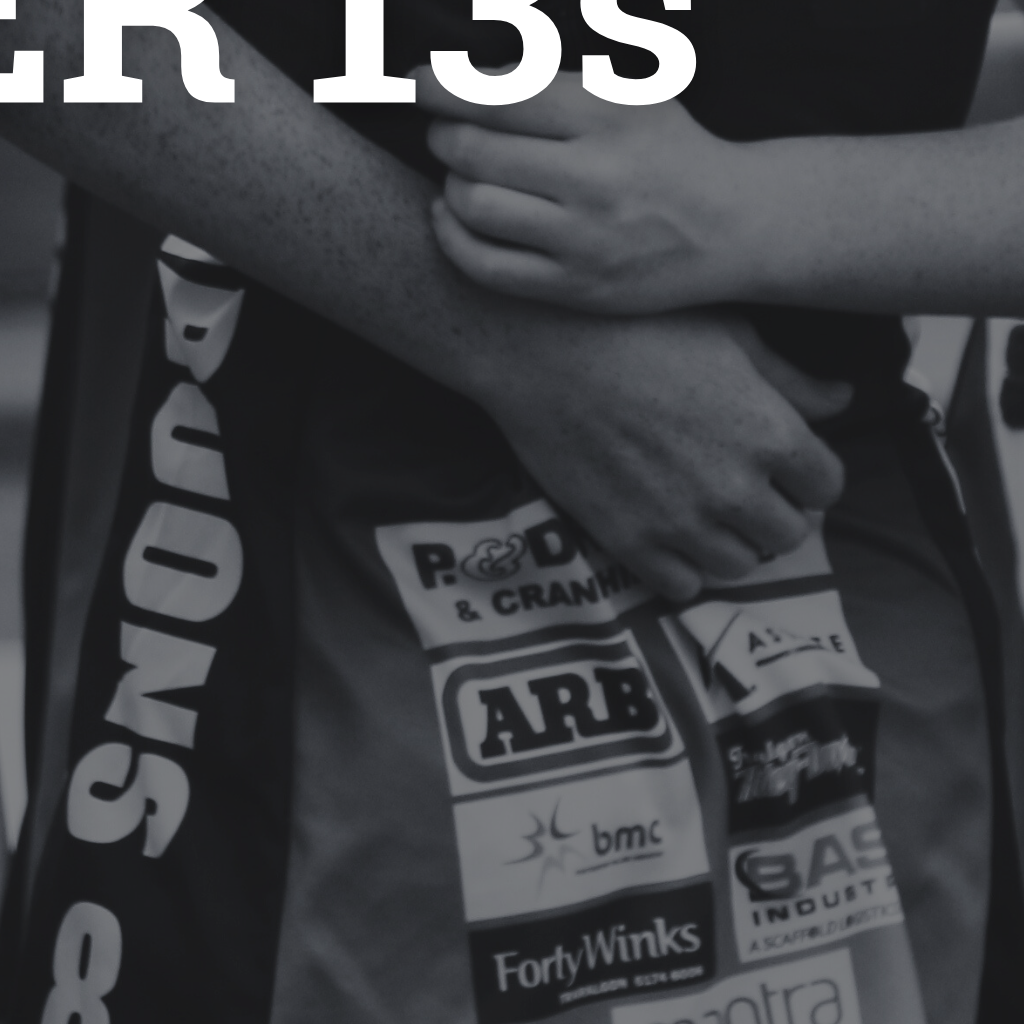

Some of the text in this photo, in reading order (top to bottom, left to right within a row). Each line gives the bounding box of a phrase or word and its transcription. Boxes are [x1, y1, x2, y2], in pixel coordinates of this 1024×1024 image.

[454, 598, 483, 623] &
[491, 576, 601, 616] CRAN
[477, 666, 662, 760] ARB
[591, 819, 663, 856] bmc
[746, 824, 888, 903] BAS
[751, 875, 895, 927] INDUST
